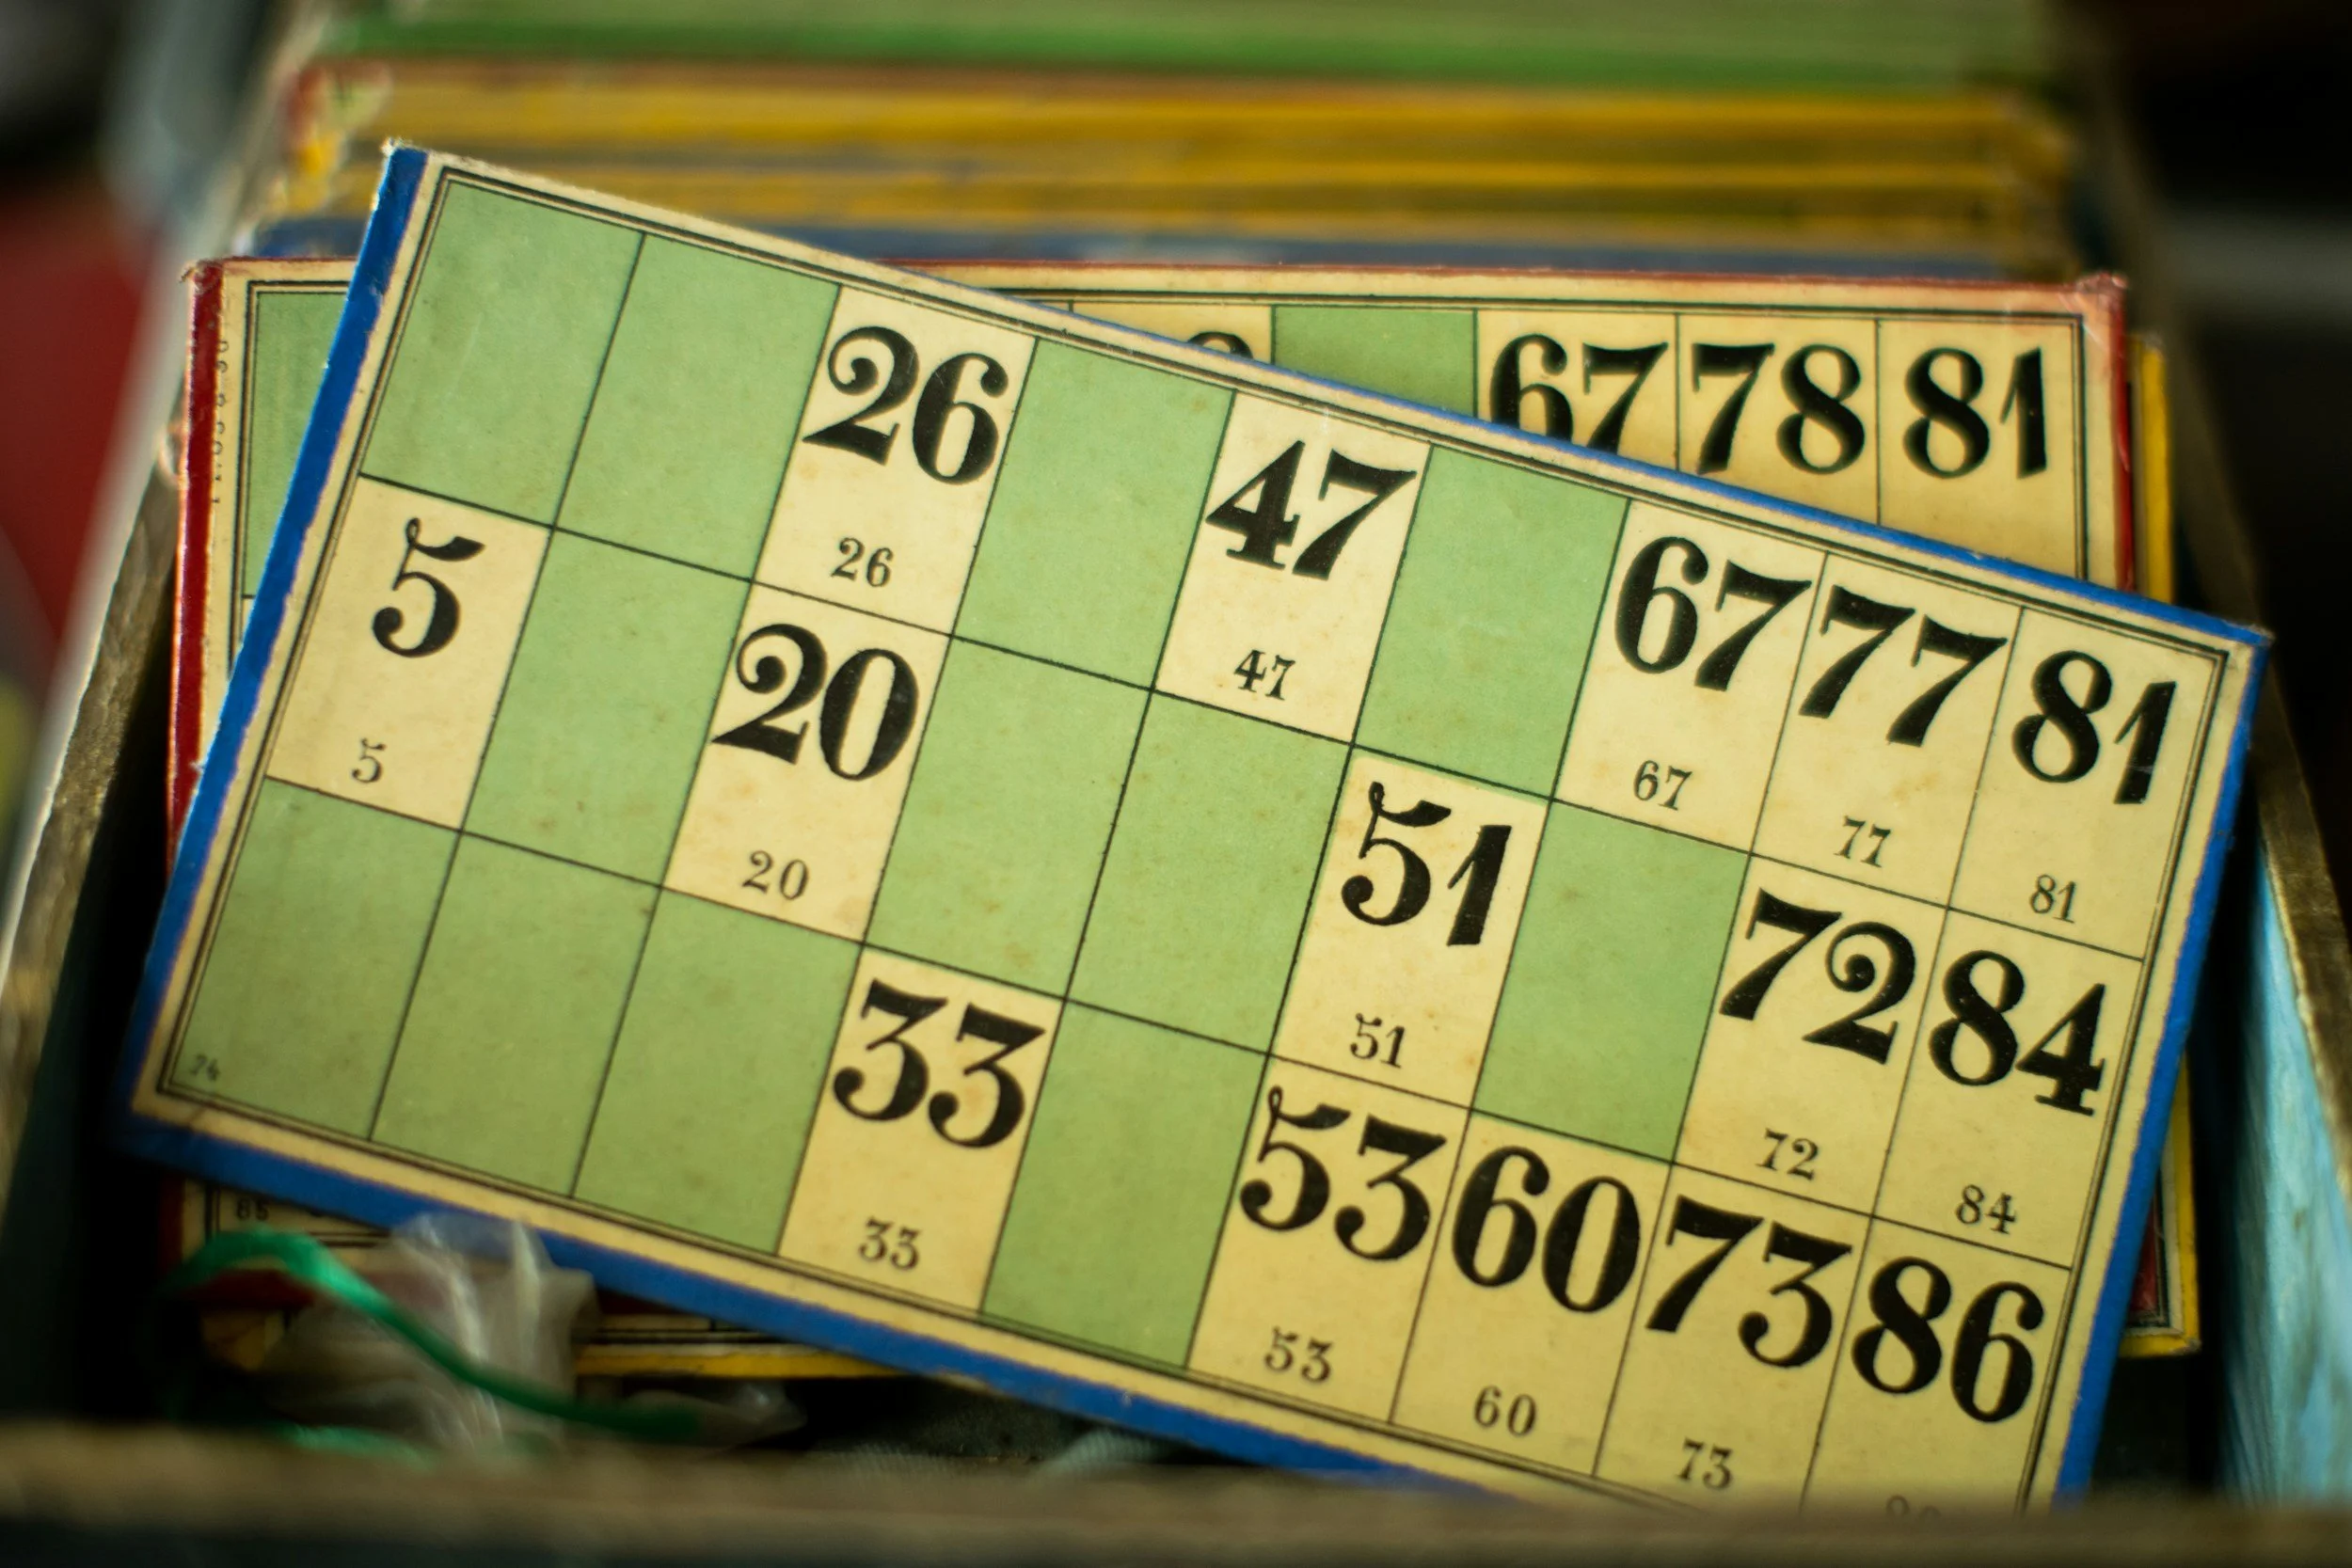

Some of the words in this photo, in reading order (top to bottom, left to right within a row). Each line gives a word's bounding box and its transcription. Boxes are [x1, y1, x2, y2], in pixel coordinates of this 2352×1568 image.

[803, 325, 1008, 485] 26
[1489, 333, 1669, 455] 67
[1691, 342, 1865, 475] 78
[1903, 347, 2048, 480] 81
[831, 536, 895, 588] 26
[1205, 440, 1418, 581] 47
[372, 516, 485, 659] 5
[1615, 536, 1813, 692] 67
[710, 623, 919, 782] 20
[1234, 648, 1296, 701] 47
[1799, 585, 2008, 749] 77
[2012, 650, 2177, 805] 81
[352, 738, 385, 784] 5
[1633, 759, 1693, 812] 67
[741, 849, 810, 901] 20
[1342, 781, 1513, 947] 51
[1838, 815, 1893, 868] 77
[2029, 873, 2077, 925] 81
[1350, 1012, 1406, 1069] 51
[1720, 888, 1916, 1066] 72
[1930, 949, 2106, 1117] 84
[832, 978, 1045, 1149] 33
[1239, 1085, 1447, 1263] 53
[1759, 1128, 1820, 1181] 72
[1956, 1183, 2017, 1235] 84
[860, 1217, 920, 1271] 33
[1453, 1146, 1641, 1315] 60
[1646, 1195, 1853, 1370] 73
[1266, 1327, 1333, 1384] 53
[1851, 1256, 2045, 1424] 86
[1474, 1386, 1537, 1436] 60
[1677, 1436, 1734, 1492] 73
